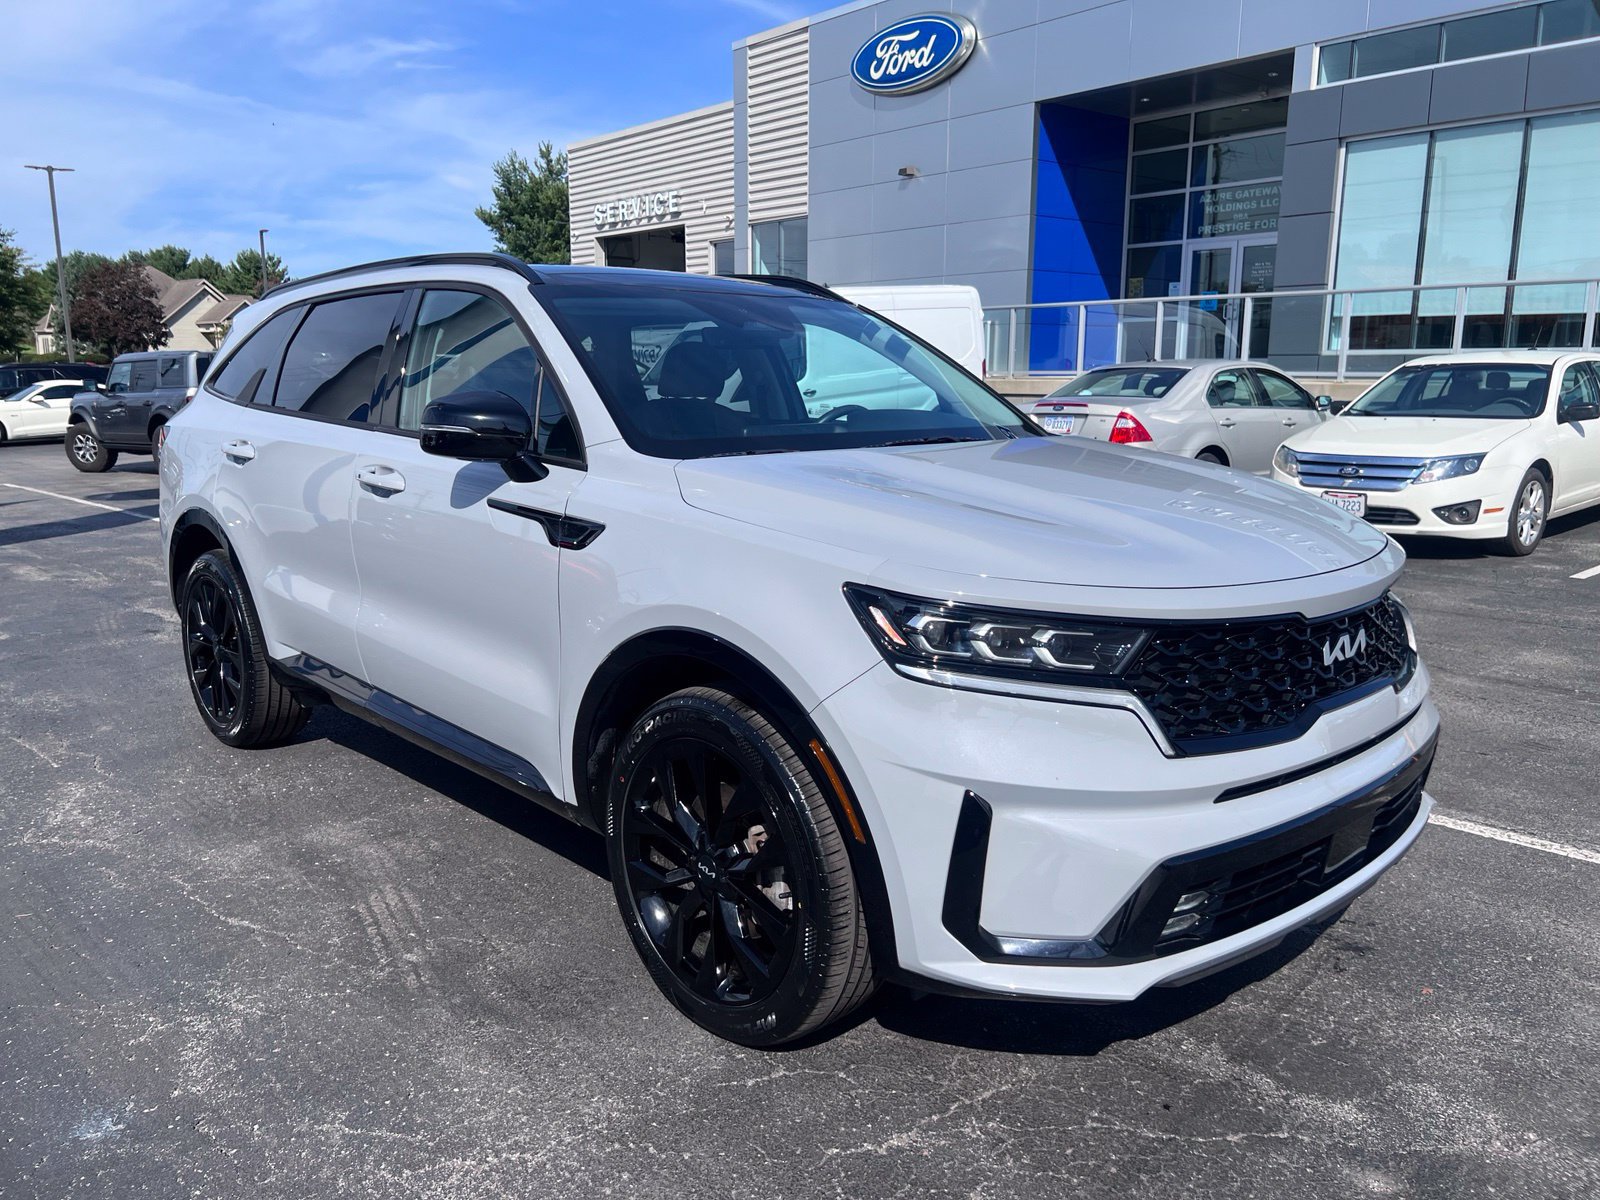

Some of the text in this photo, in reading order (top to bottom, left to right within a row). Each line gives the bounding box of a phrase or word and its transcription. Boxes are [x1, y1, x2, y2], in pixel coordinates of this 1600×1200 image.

[869, 29, 937, 80] Ford
[1199, 191, 1233, 204] AZURE
[1205, 198, 1280, 214] HOLDINGS LLC
[593, 190, 679, 225] SERVICE
[1197, 218, 1277, 236] PRESTIGE FOR
